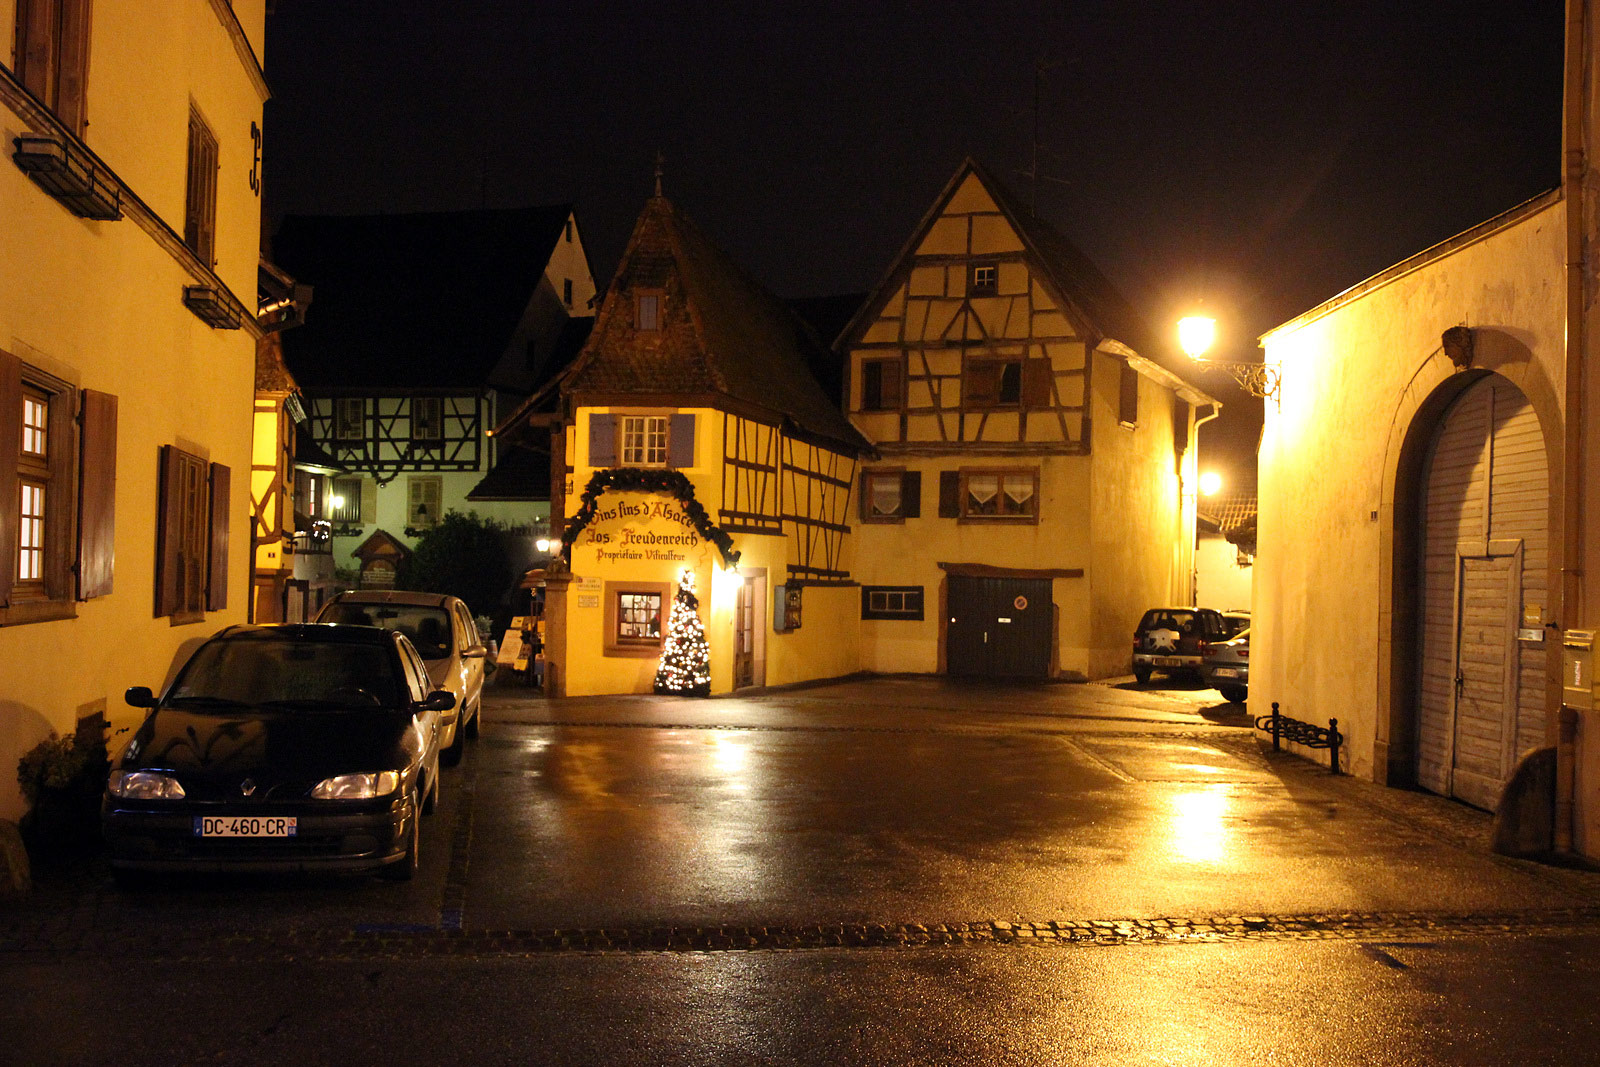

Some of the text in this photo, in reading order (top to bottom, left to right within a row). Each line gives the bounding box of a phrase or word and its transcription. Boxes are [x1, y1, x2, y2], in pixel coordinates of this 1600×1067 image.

[618, 501, 640, 518] fins
[620, 528, 698, 549] Freudenreich
[645, 549, 686, 561] Viticulteur
[204, 819, 286, 835] DC-460-CR
